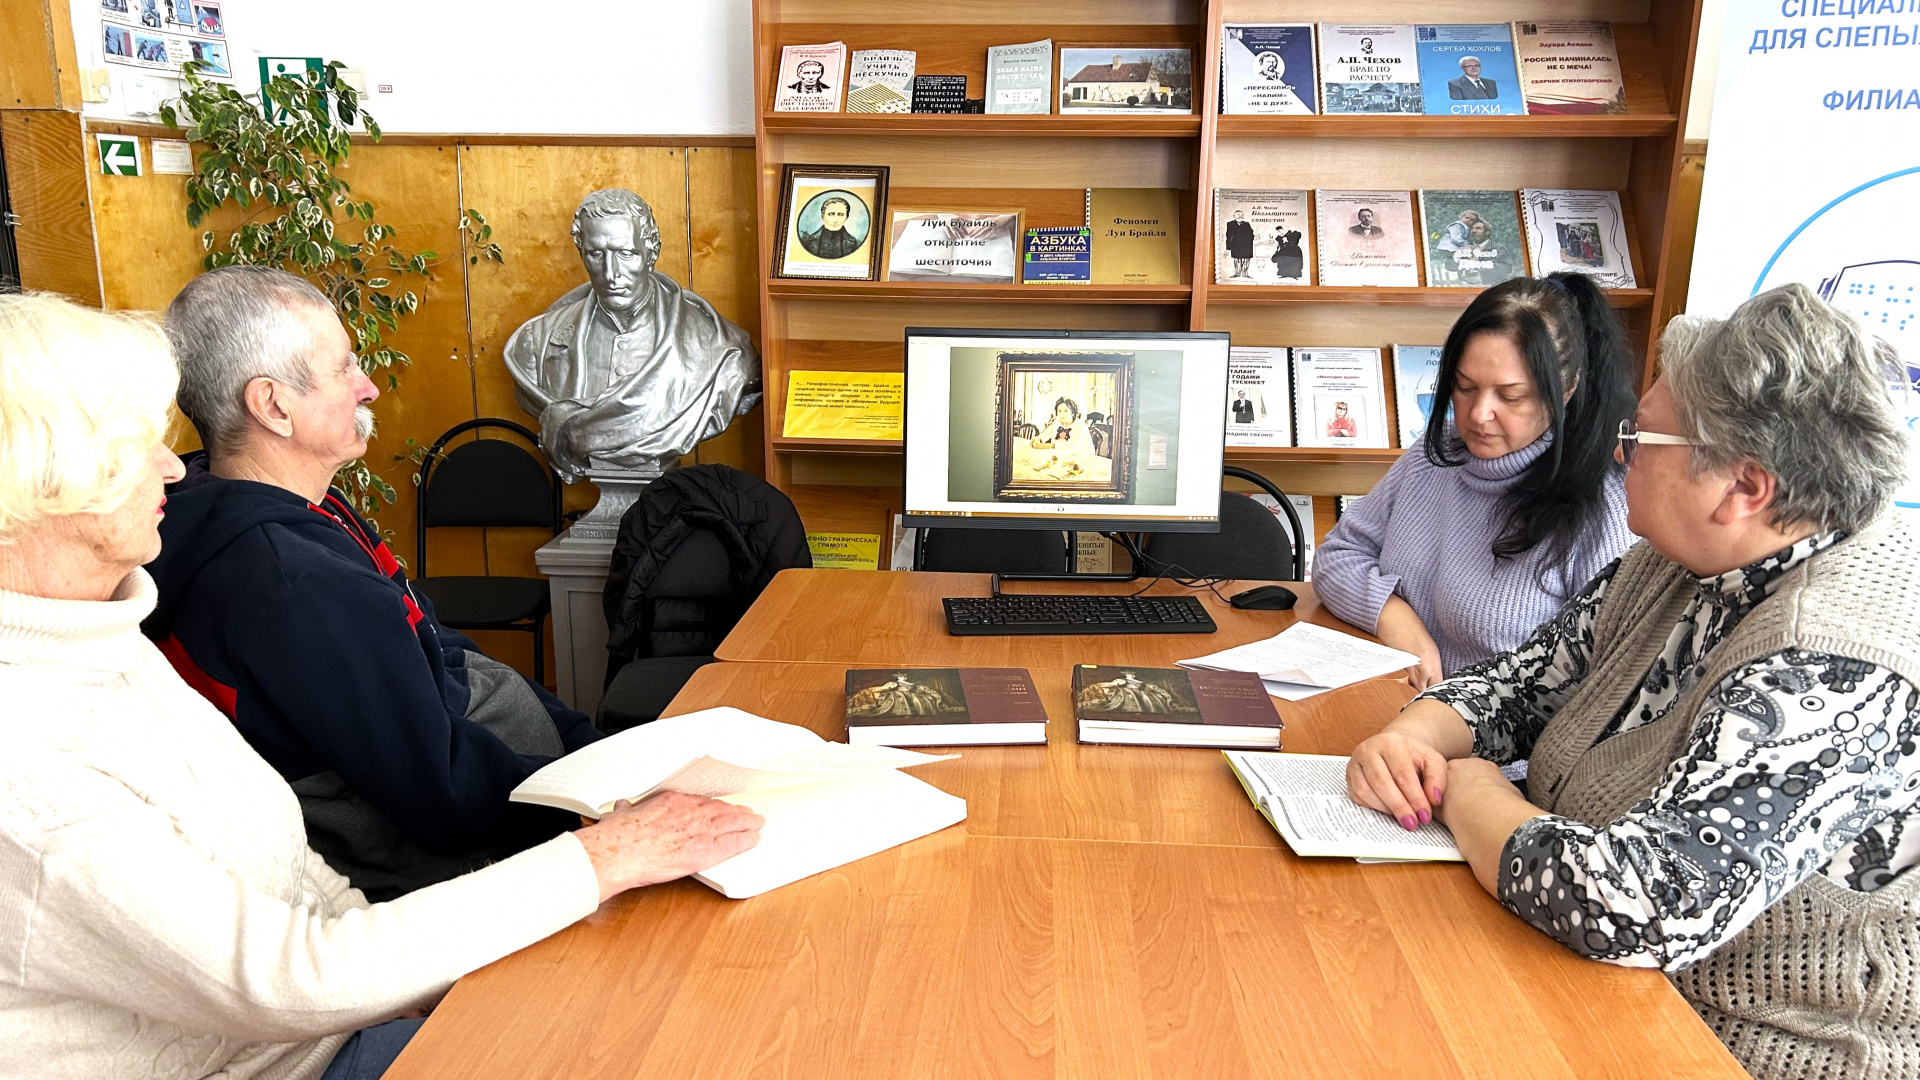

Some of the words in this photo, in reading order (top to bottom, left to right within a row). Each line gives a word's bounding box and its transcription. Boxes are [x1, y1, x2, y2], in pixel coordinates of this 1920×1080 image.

[1781, 0, 1920, 19] СПЕЦИАЛ
[1748, 28, 1807, 54] ДЛЯ
[1815, 24, 1920, 48] СЛЕПЫ
[1337, 56, 1361, 64] А.П.
[1363, 56, 1402, 64] ЧЕХОВ
[1822, 88, 1920, 111] ФИЛИА
[1450, 104, 1501, 114] СТИХИ
[921, 218, 947, 229] Луи
[950, 217, 997, 229] Брайль
[1113, 217, 1159, 225] Феномен
[1105, 229, 1126, 238] Луи
[1129, 229, 1166, 238] Брайля
[924, 239, 986, 248] открытие
[1030, 236, 1087, 245] АЗБУКА
[915, 258, 992, 267] шеститочия
[1430, 348, 1443, 357] Ку
[805, 535, 878, 544] ЕФНО-ГРАФИЧЕСКАЯ
